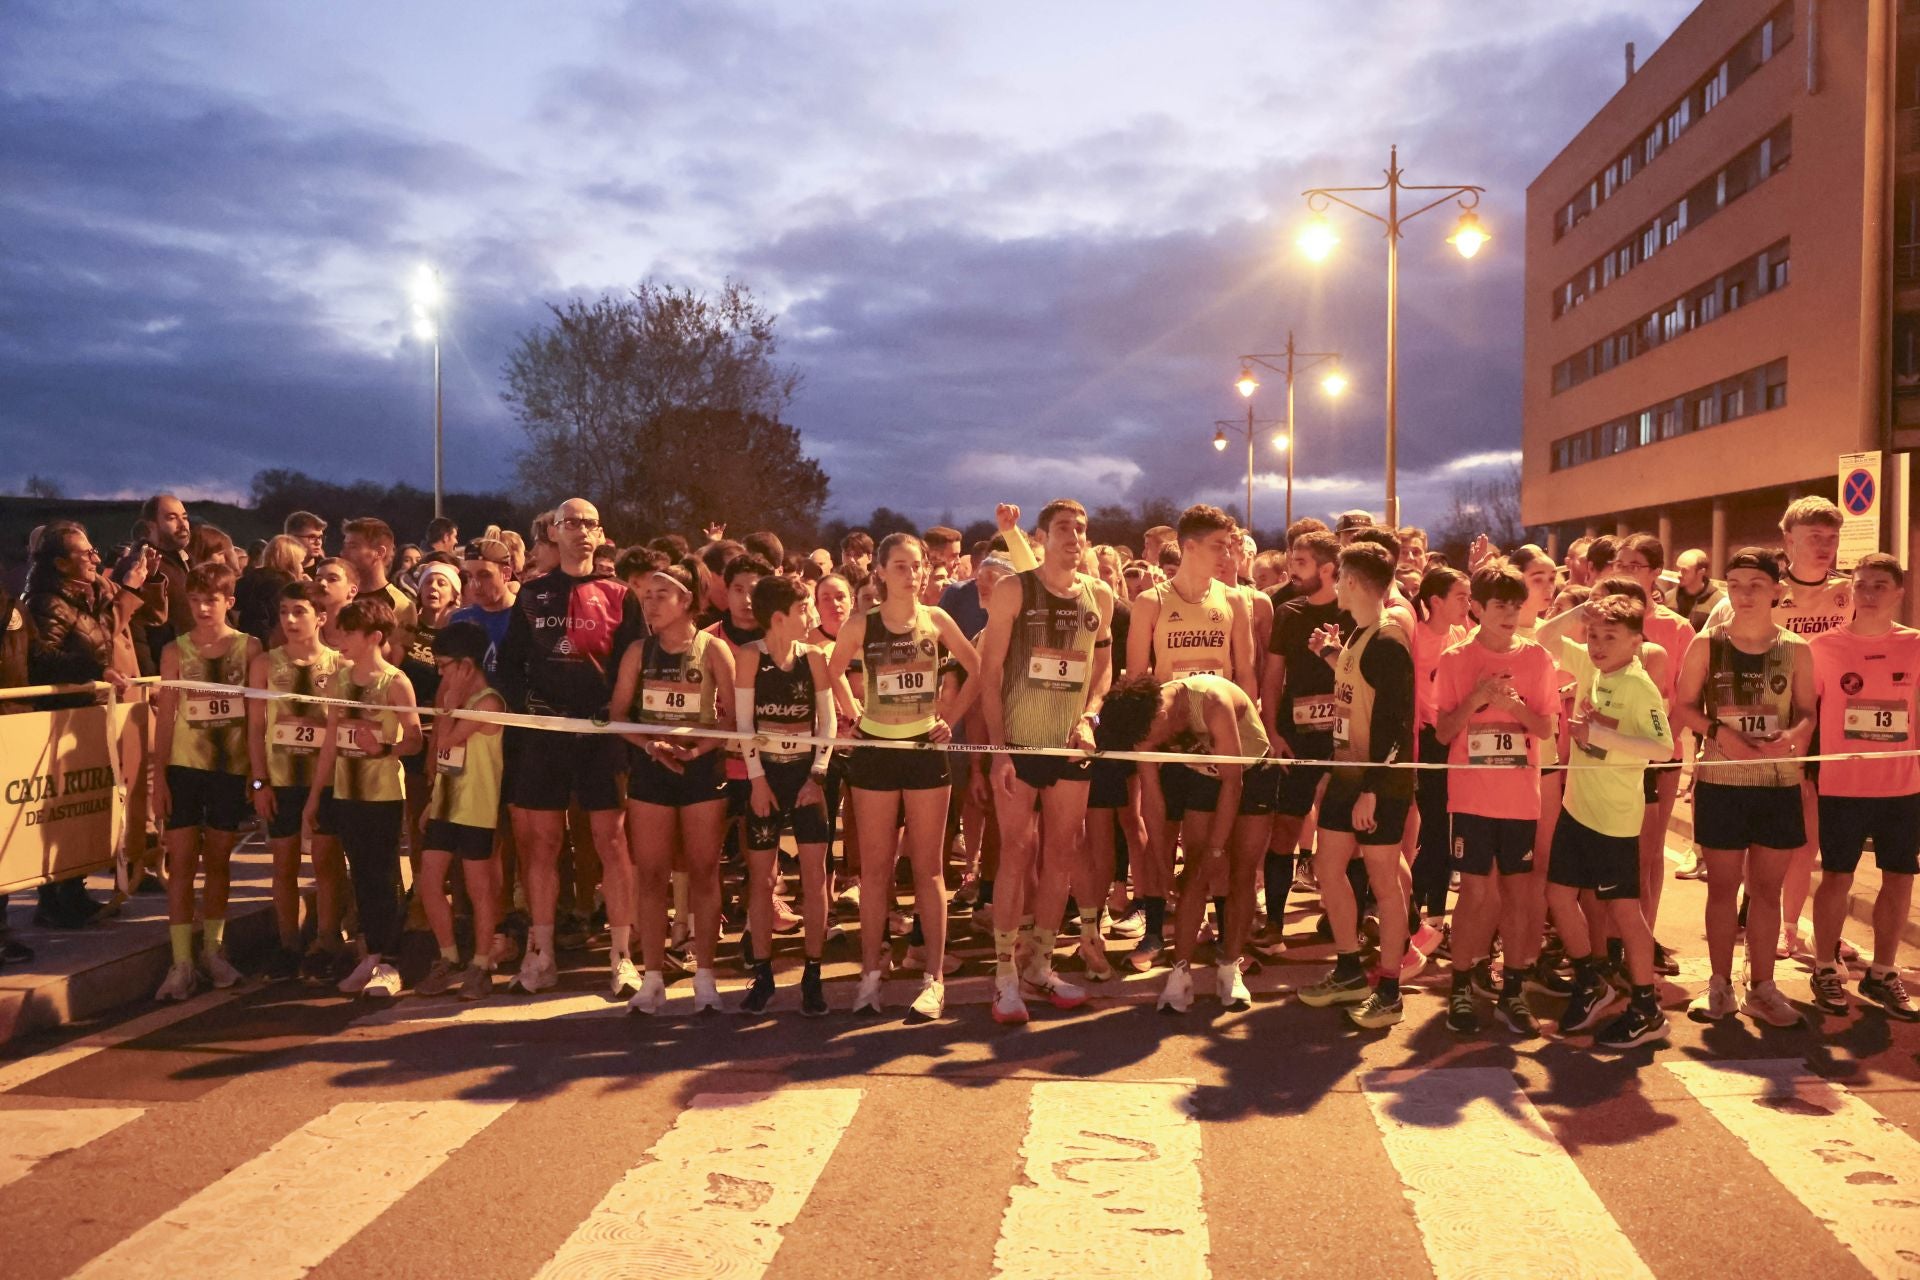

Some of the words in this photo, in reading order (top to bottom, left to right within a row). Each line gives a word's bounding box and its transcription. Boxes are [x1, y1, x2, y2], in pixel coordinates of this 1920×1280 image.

[547, 616, 596, 631] OVIEDO
[1168, 636, 1225, 649] LUGONES
[1059, 661, 1068, 676] 3
[896, 673, 924, 689] 180
[209, 700, 230, 715] 96
[666, 692, 685, 708] 48
[756, 703, 810, 719] WOLVES
[1309, 703, 1334, 719] 222
[1873, 711, 1893, 727] 13
[1739, 716, 1766, 732] 174
[295, 727, 315, 742] 23
[1494, 734, 1513, 750] 78
[5, 774, 58, 805] CAJA
[63, 765, 117, 795] RURA
[25, 808, 45, 827] DE
